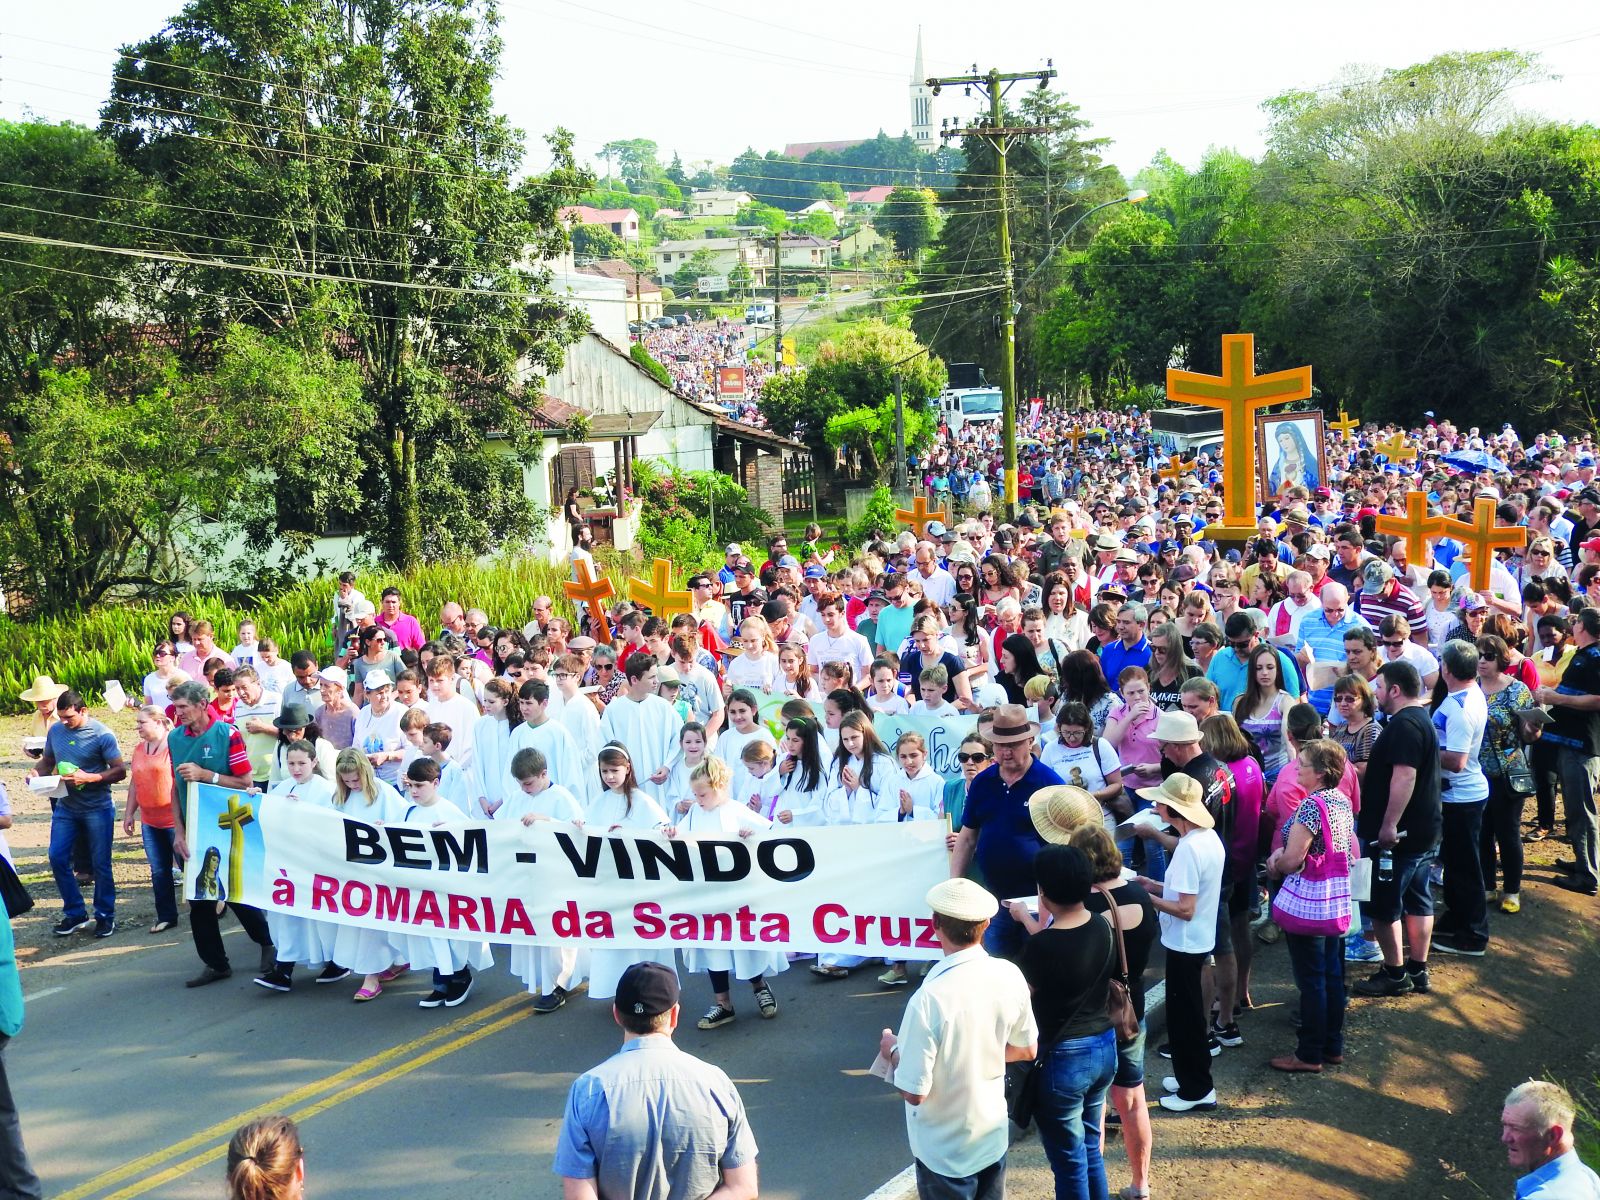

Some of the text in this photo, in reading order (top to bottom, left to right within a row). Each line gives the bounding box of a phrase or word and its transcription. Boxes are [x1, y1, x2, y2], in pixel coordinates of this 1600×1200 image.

[342, 818, 489, 874] BEM
[553, 831, 816, 883] VINDO
[272, 869, 942, 949] à ROMARIA da Santa Cruz
